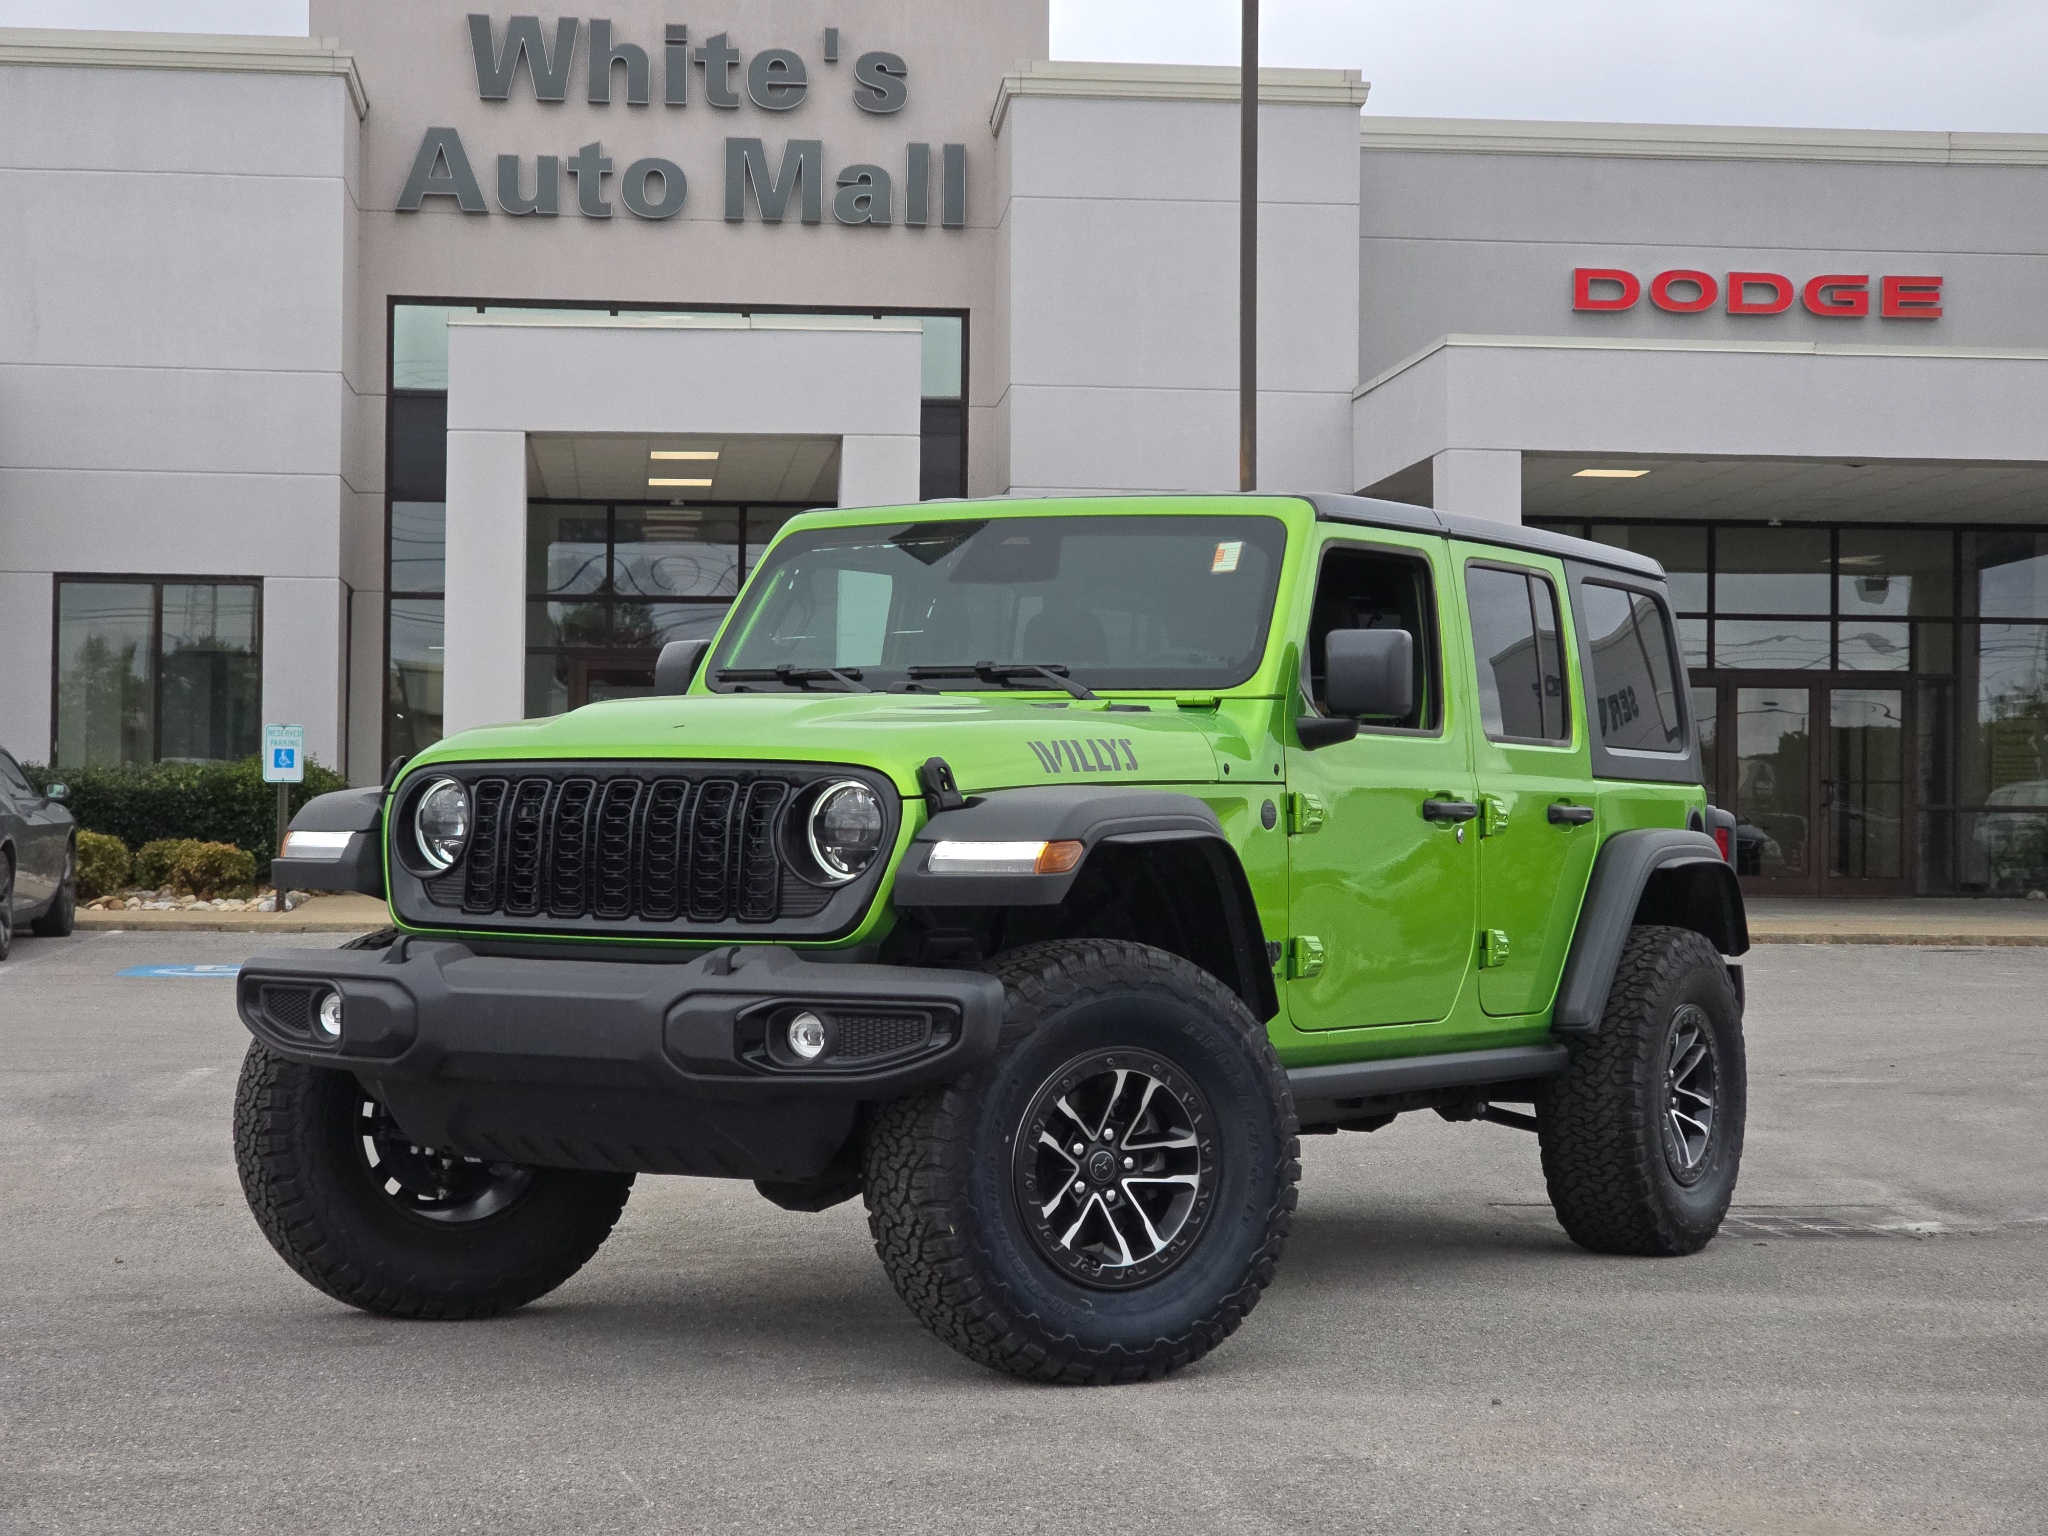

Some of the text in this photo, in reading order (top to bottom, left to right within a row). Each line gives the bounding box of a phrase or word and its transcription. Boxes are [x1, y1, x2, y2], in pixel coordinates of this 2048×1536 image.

[467, 13, 909, 114] White's
[395, 126, 967, 229] Auto Mall
[1572, 267, 1944, 319] DODGE
[267, 729, 302, 737] RESERVED
[270, 739, 300, 747] PARKING
[1026, 738, 1139, 774] WILLYS
